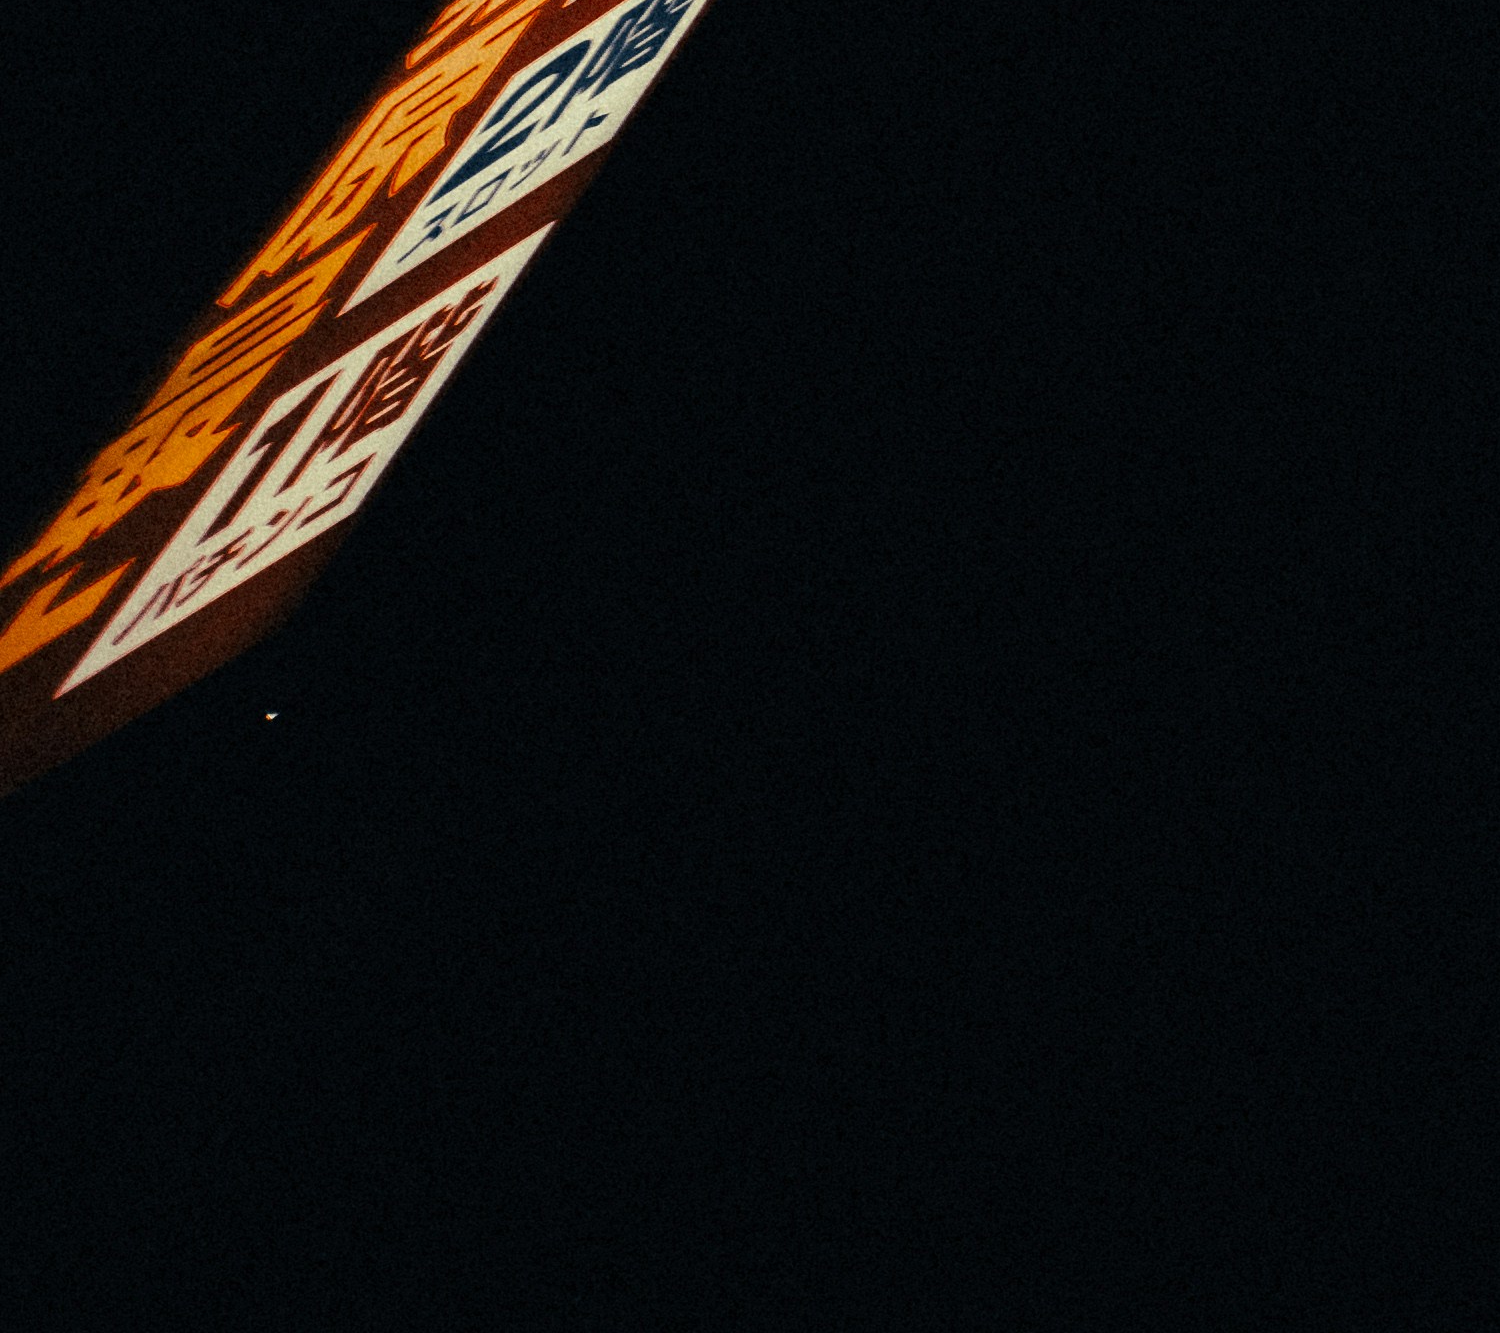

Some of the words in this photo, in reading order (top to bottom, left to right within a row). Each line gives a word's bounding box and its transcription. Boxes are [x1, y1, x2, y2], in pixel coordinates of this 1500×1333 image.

[396, 109, 609, 264] スロット
[194, 275, 499, 547] 1階
[110, 451, 376, 647] パチンコ
